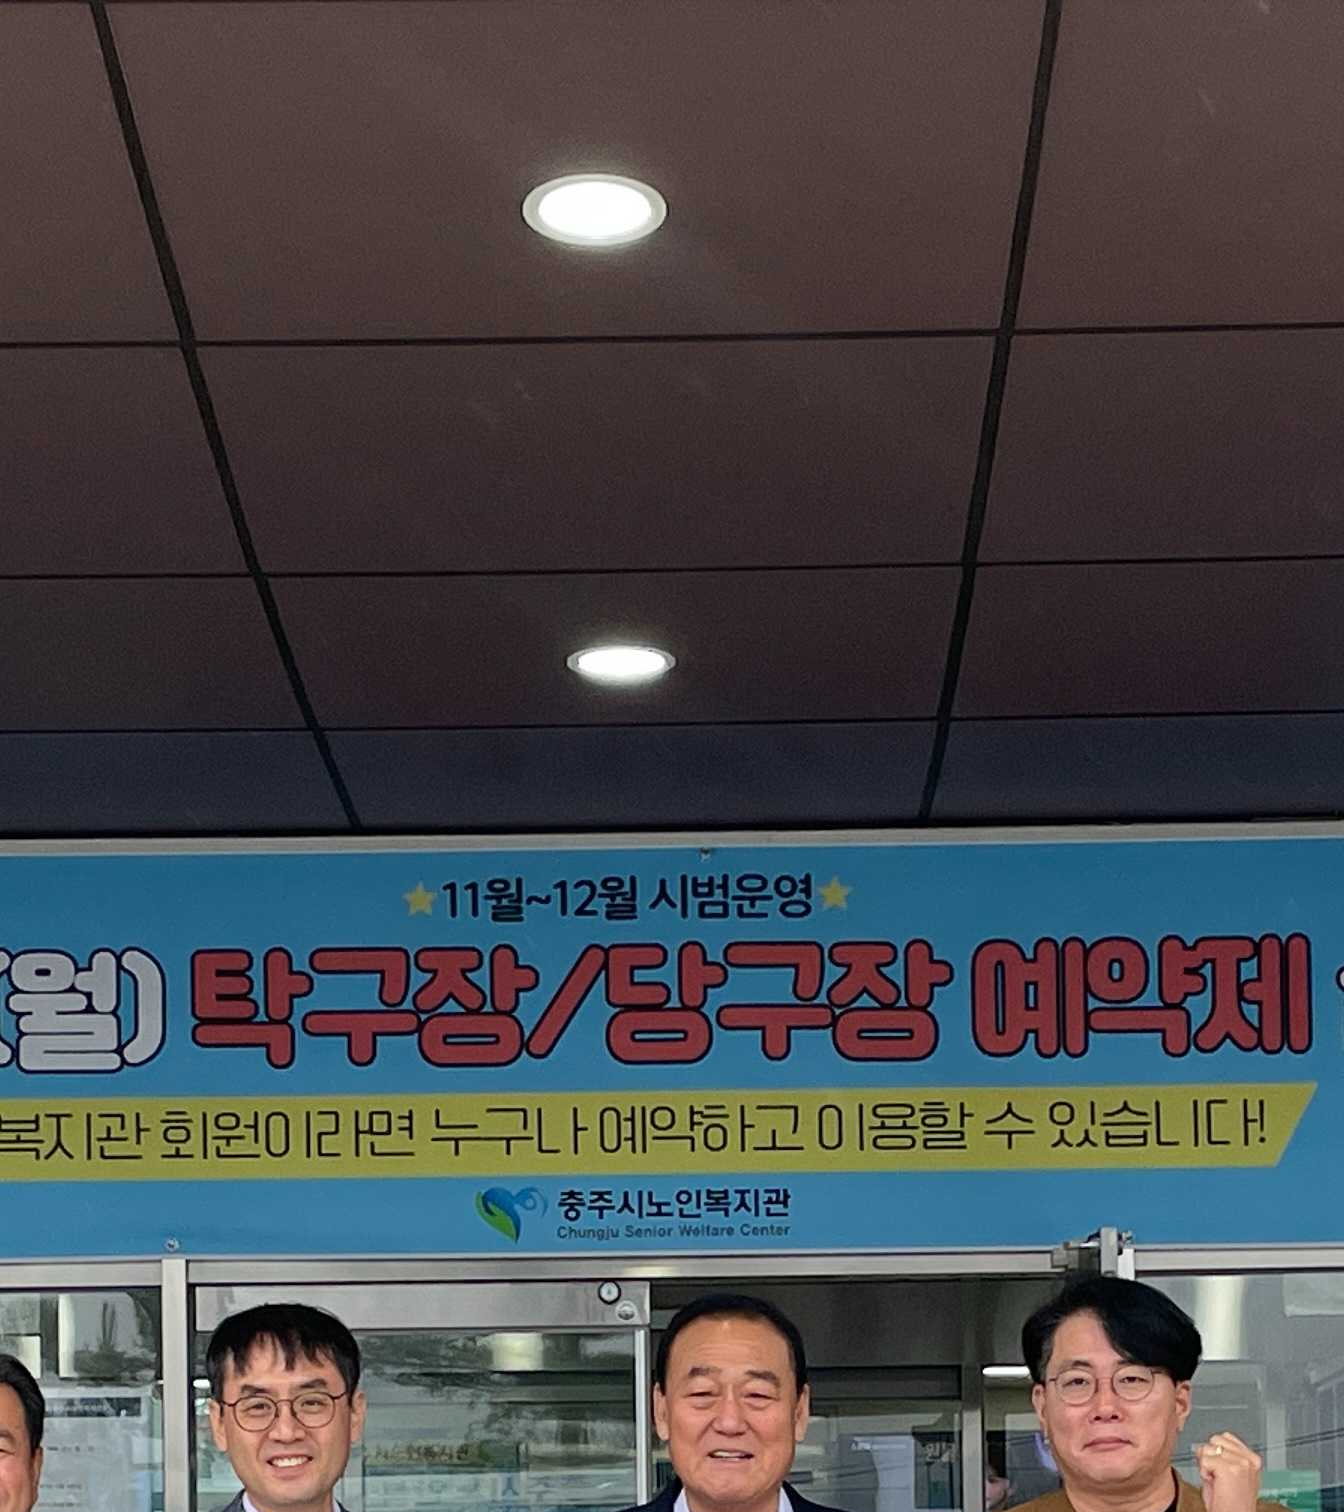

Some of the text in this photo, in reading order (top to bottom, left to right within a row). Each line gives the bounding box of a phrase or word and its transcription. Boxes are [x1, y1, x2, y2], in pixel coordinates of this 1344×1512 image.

[441, 872, 815, 924] 11월~12월 시범운영
[190, 934, 952, 1069] 탁구장/당구장
[970, 933, 1312, 1064] 예약제
[159, 1109, 416, 1161] 회원이라면
[430, 1105, 589, 1159] 누구나
[598, 1101, 805, 1157] 예약하고
[817, 1099, 975, 1152] 이용할
[983, 1101, 1036, 1151] 수
[1047, 1097, 1268, 1150] 있습니다!
[557, 1187, 792, 1222] 충주시노인복지관
[557, 1222, 791, 1241] Chungju Senior Welfare Center
